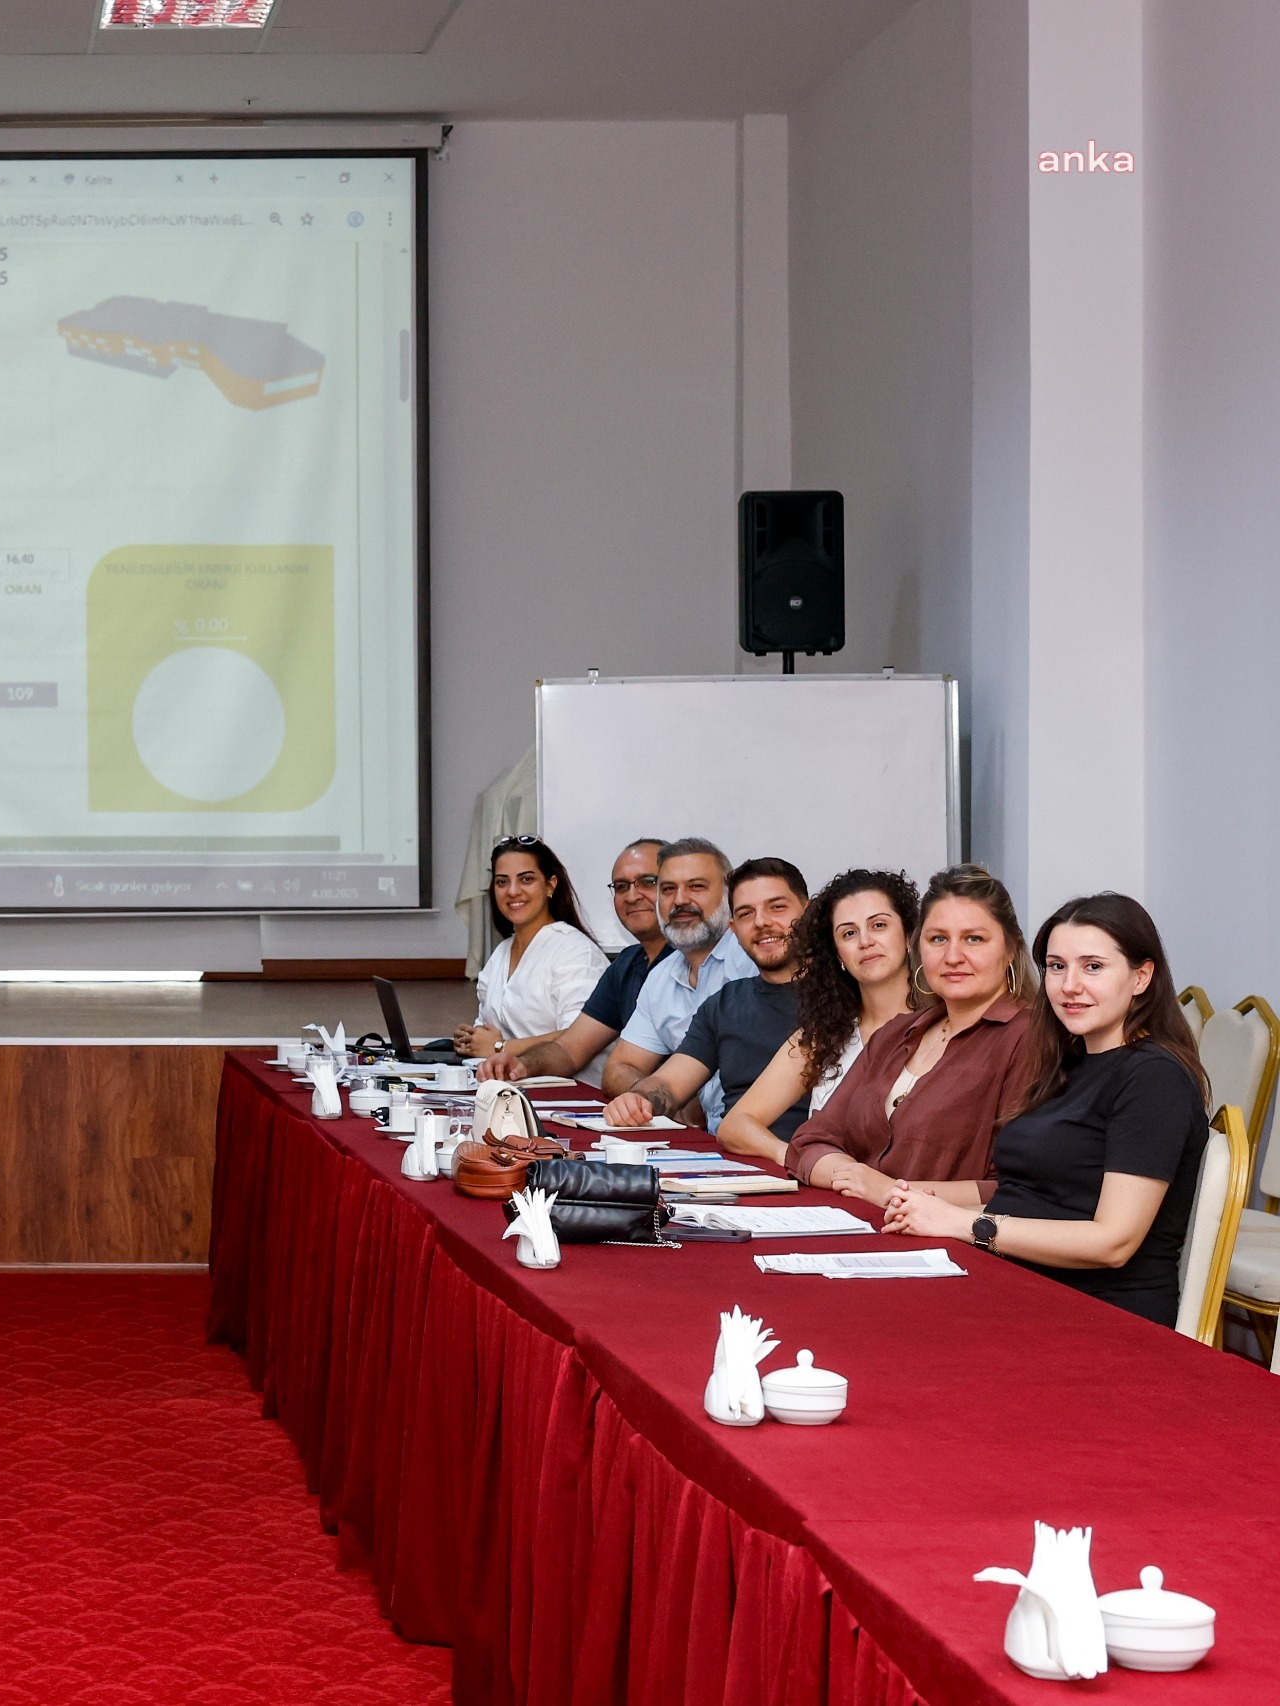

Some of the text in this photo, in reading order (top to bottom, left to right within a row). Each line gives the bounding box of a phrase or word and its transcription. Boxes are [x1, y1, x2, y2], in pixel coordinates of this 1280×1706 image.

[85, 175, 114, 186] Kalite
[5, 584, 42, 596] ORAN
[173, 619, 188, 634] %
[7, 687, 34, 700] 109
[109, 880, 148, 896] günler
[151, 879, 192, 896] geliyor
